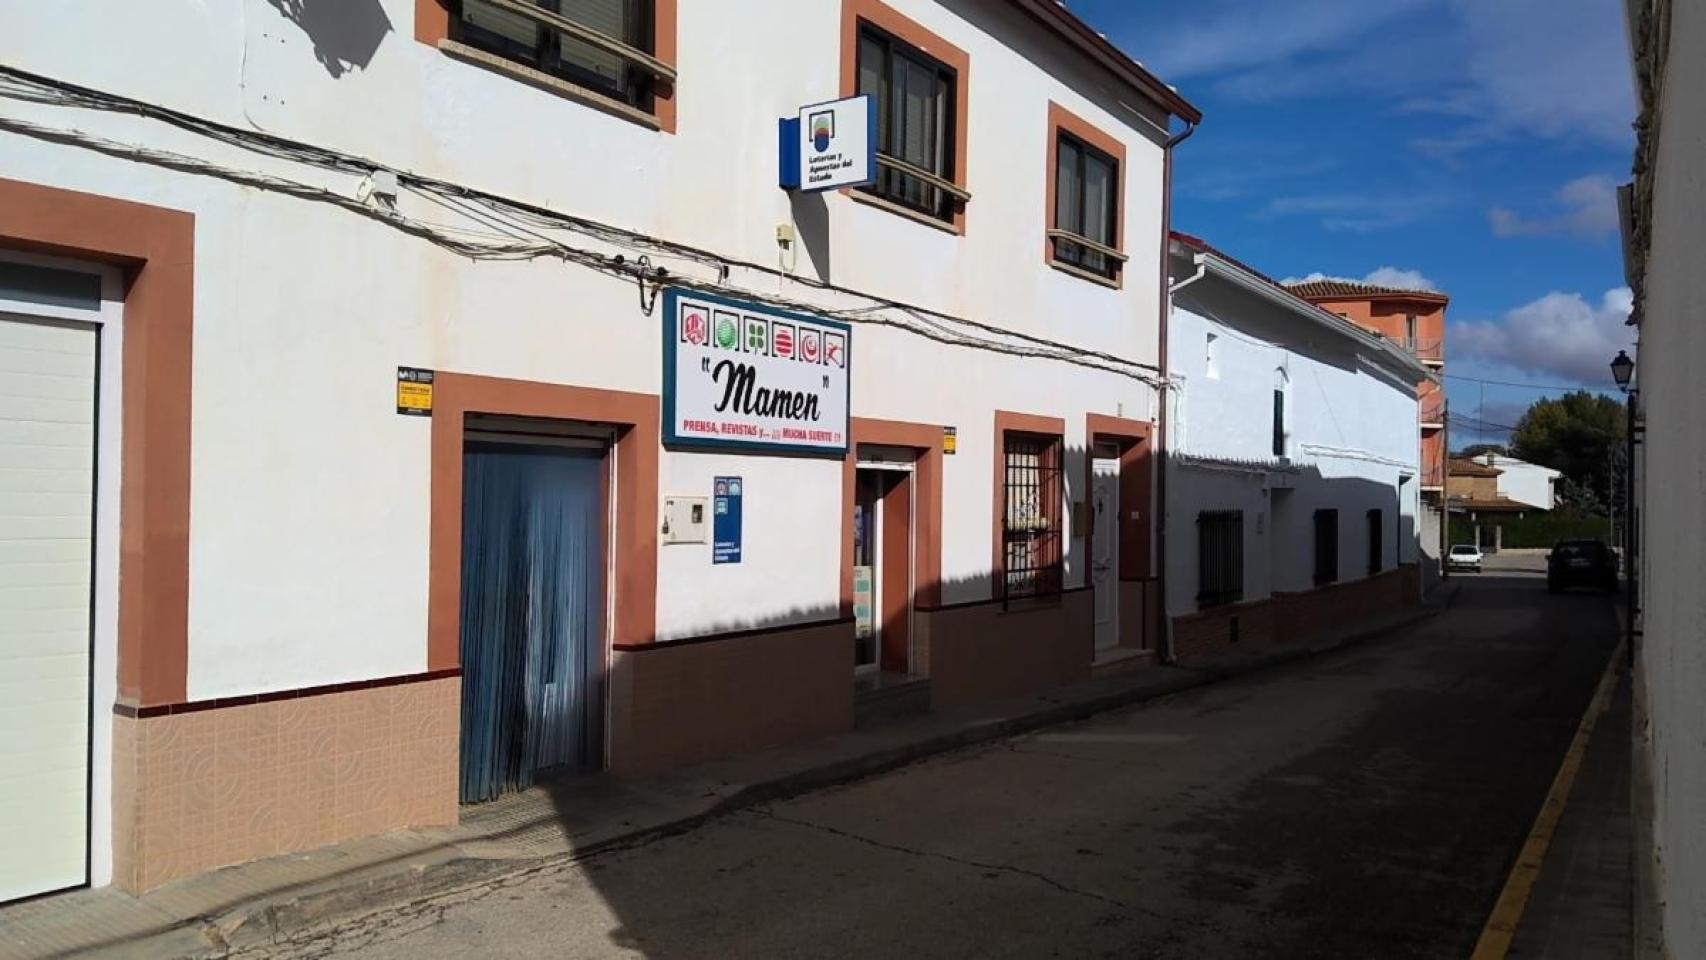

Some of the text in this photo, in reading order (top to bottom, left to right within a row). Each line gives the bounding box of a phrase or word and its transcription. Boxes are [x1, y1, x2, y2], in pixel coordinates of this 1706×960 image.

[683, 419, 719, 435] PRENSA,
[721, 422, 757, 436] REVISTAS
[782, 427, 807, 440] MUCHA
[808, 430, 833, 442] SUERTE
